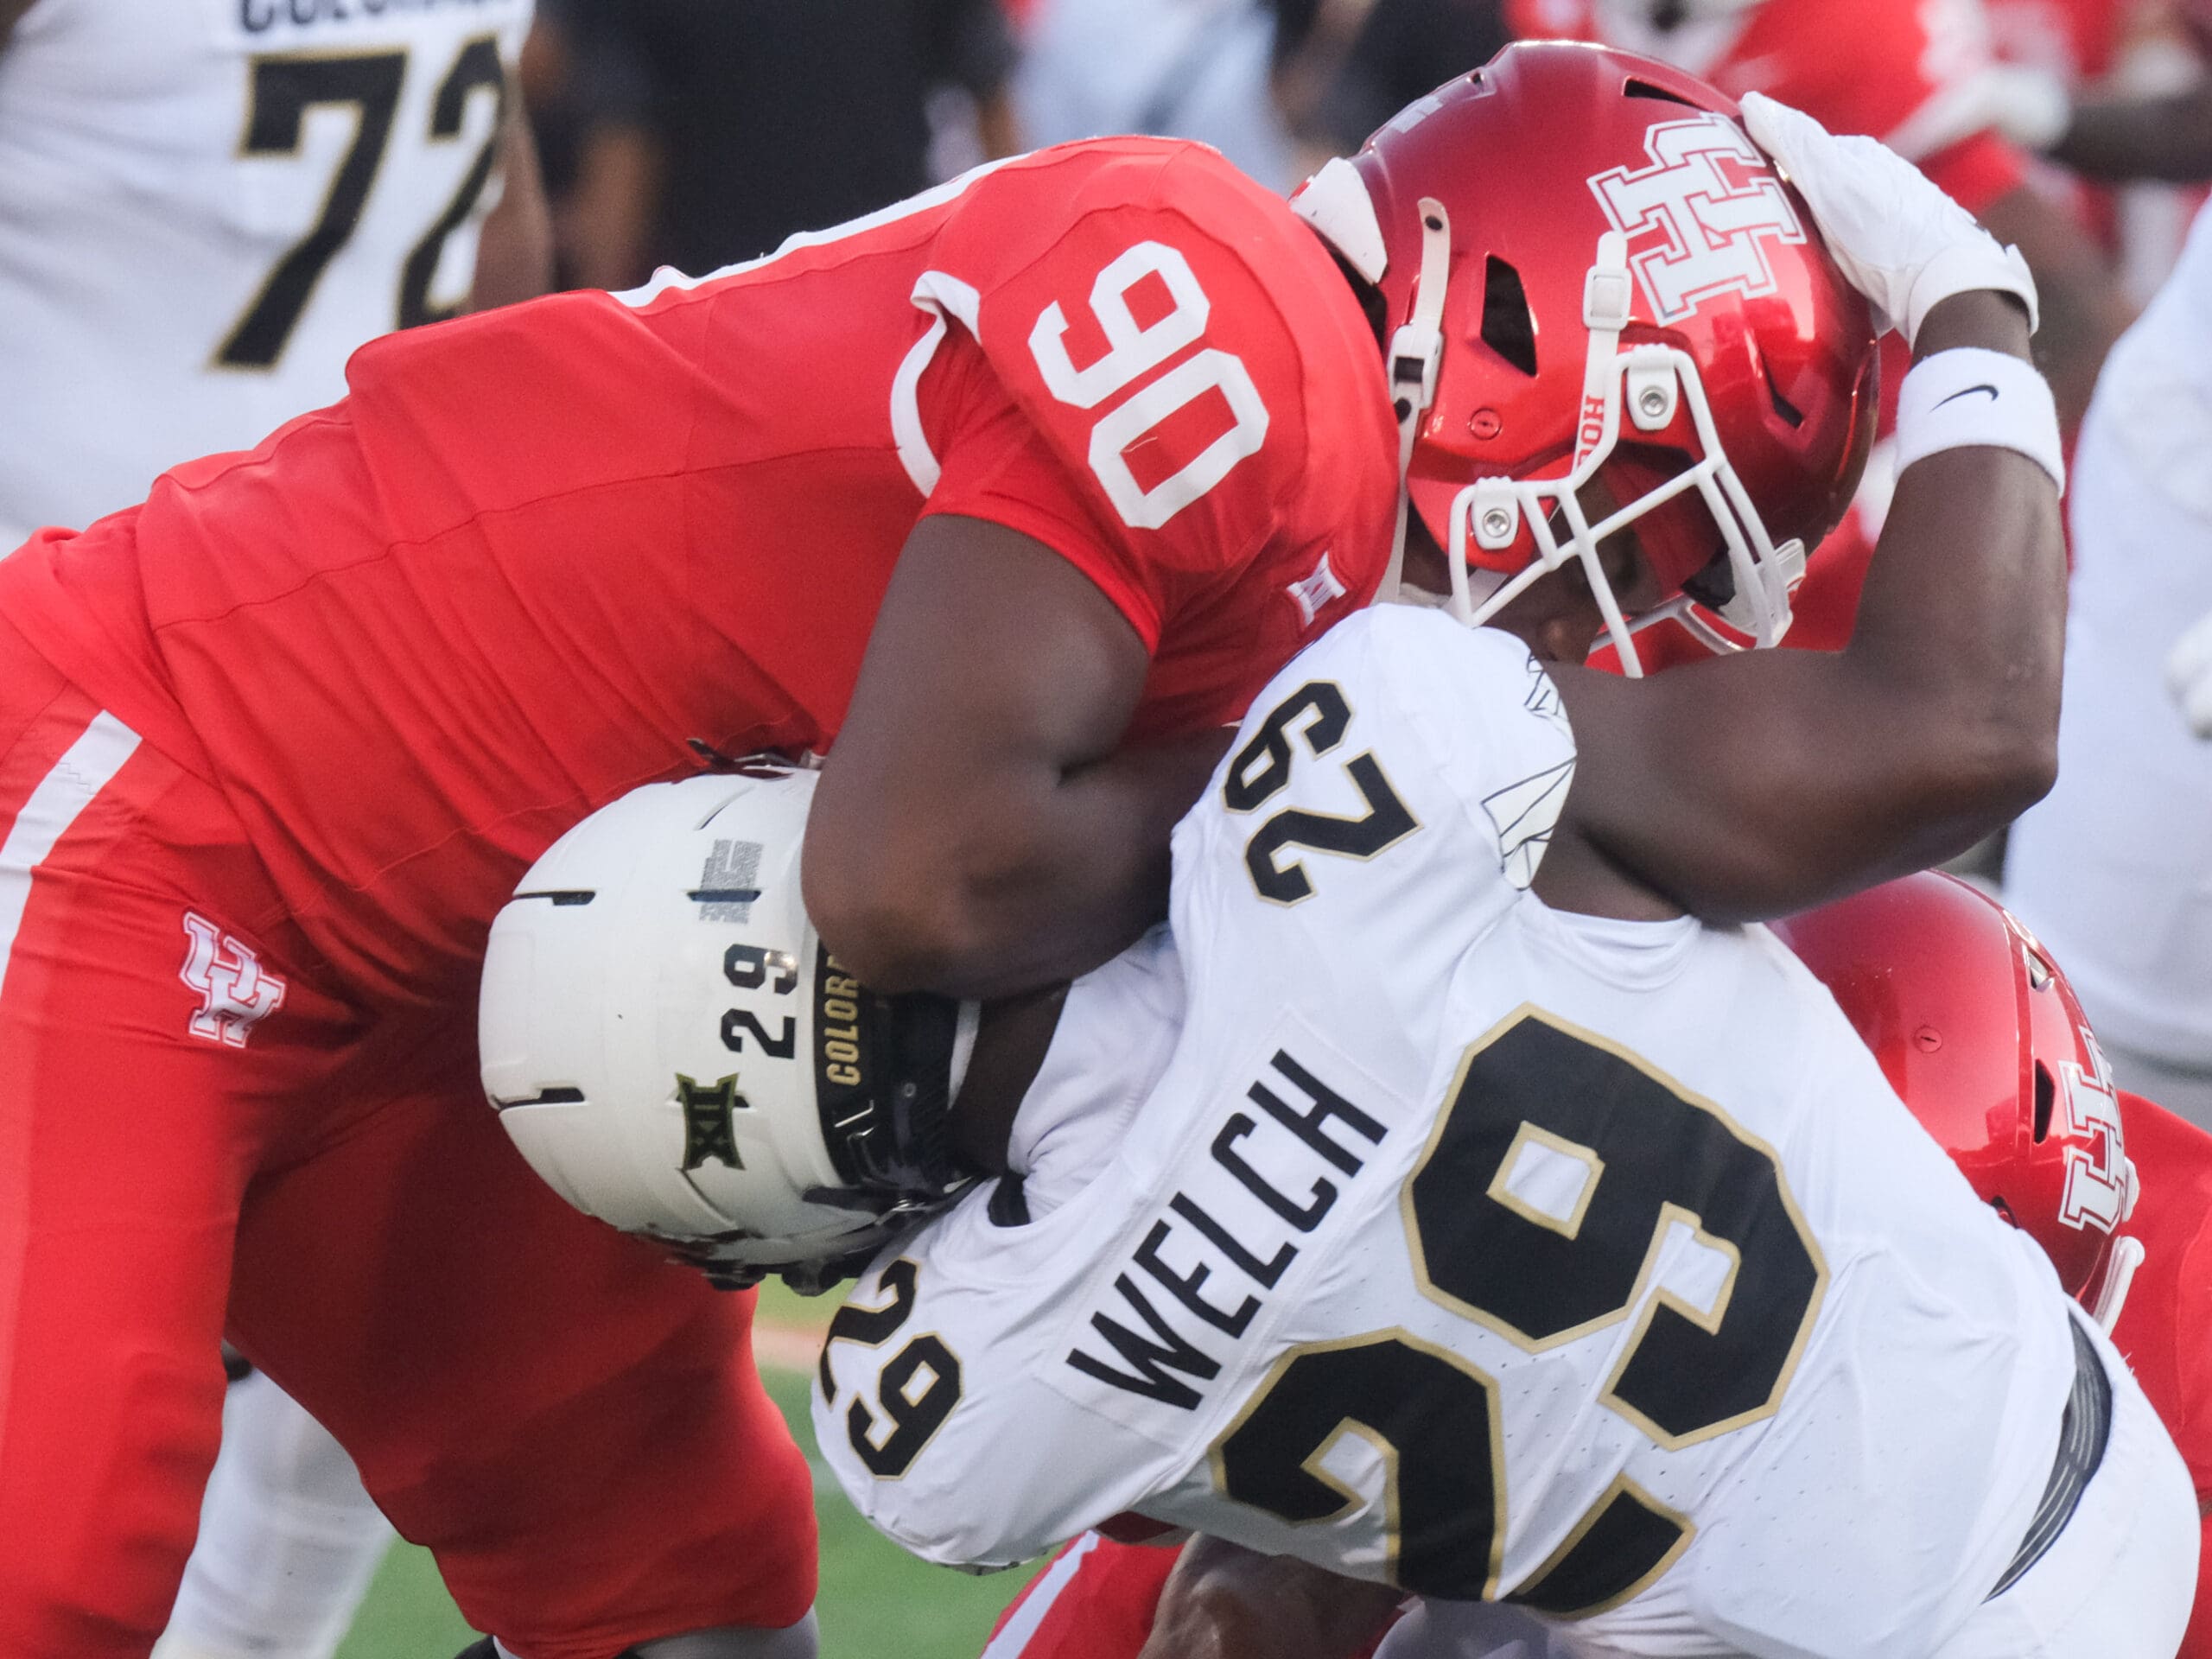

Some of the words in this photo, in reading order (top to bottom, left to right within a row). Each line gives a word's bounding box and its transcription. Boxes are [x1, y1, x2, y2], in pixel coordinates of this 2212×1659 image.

[206, 33, 506, 372] 72
[1027, 240, 1270, 530] 90
[1220, 678, 1426, 909] 29
[721, 944, 798, 1059] 29
[819, 1258, 963, 1480] 29
[1065, 1048, 1389, 1412] WELCH
[1210, 1001, 1831, 1622] 29
